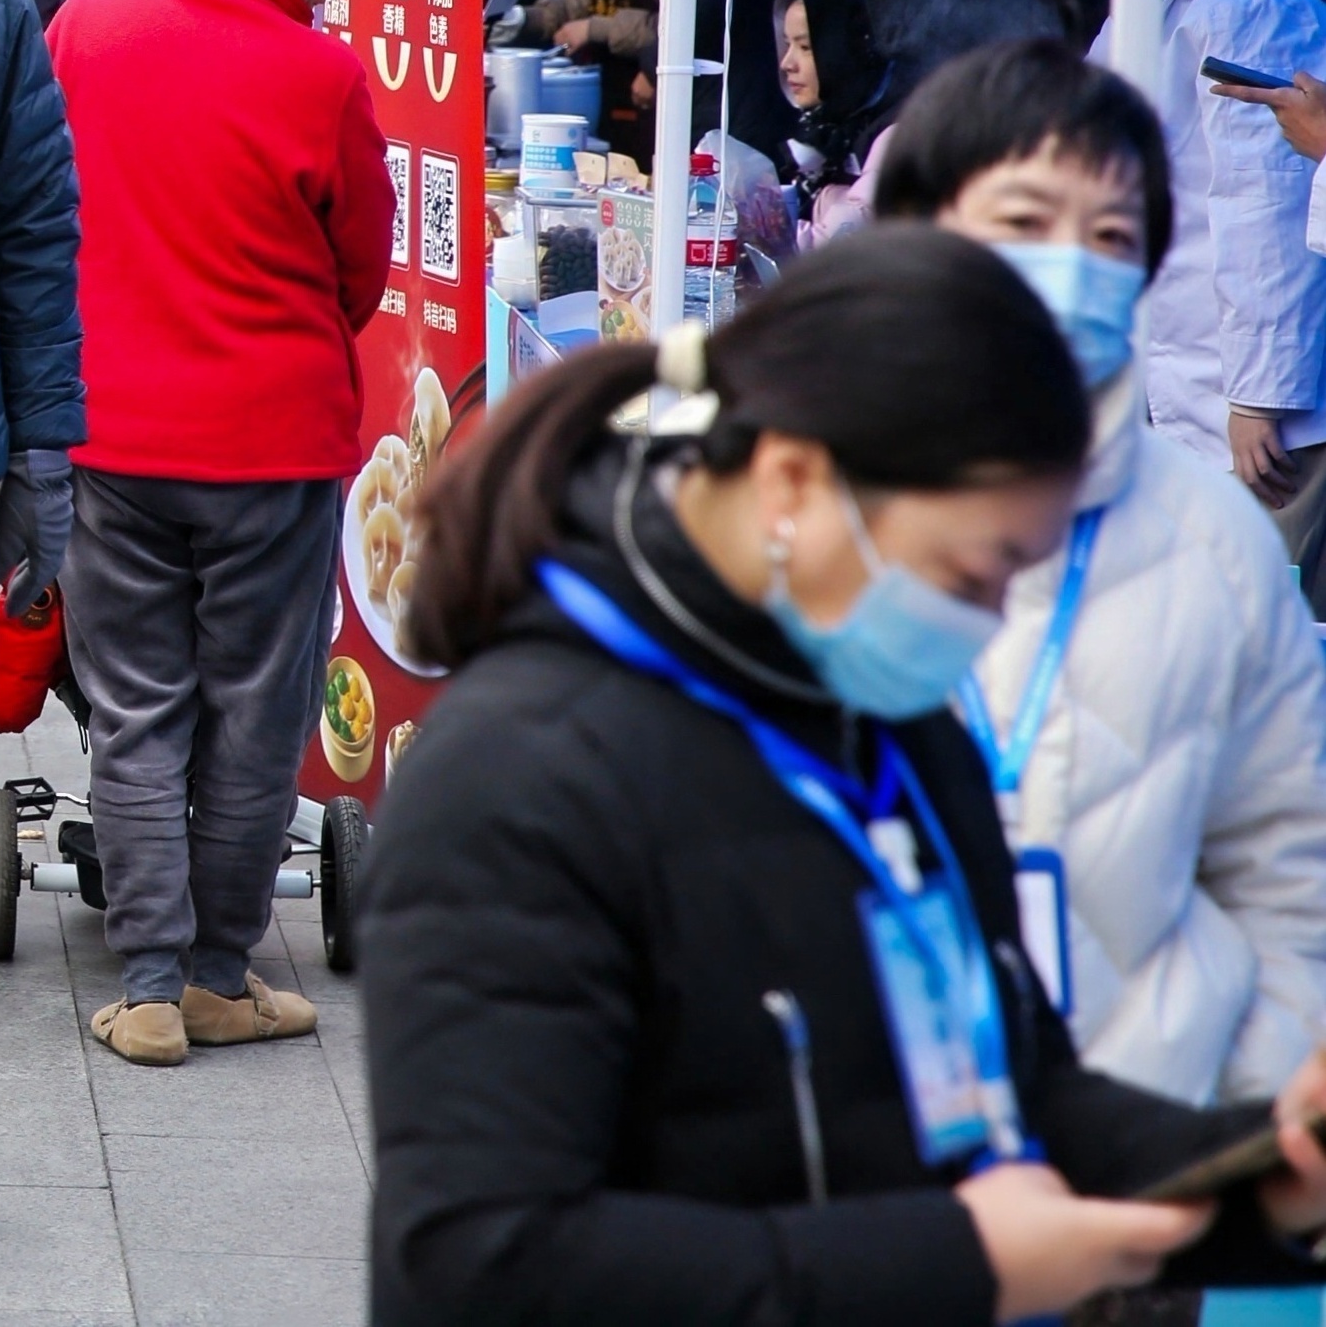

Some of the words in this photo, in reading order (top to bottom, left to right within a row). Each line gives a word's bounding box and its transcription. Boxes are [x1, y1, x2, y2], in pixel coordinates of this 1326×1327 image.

[383, 3, 405, 36] 香精
[429, 12, 448, 47] 色素
[423, 299, 456, 334] 抖音扫码
